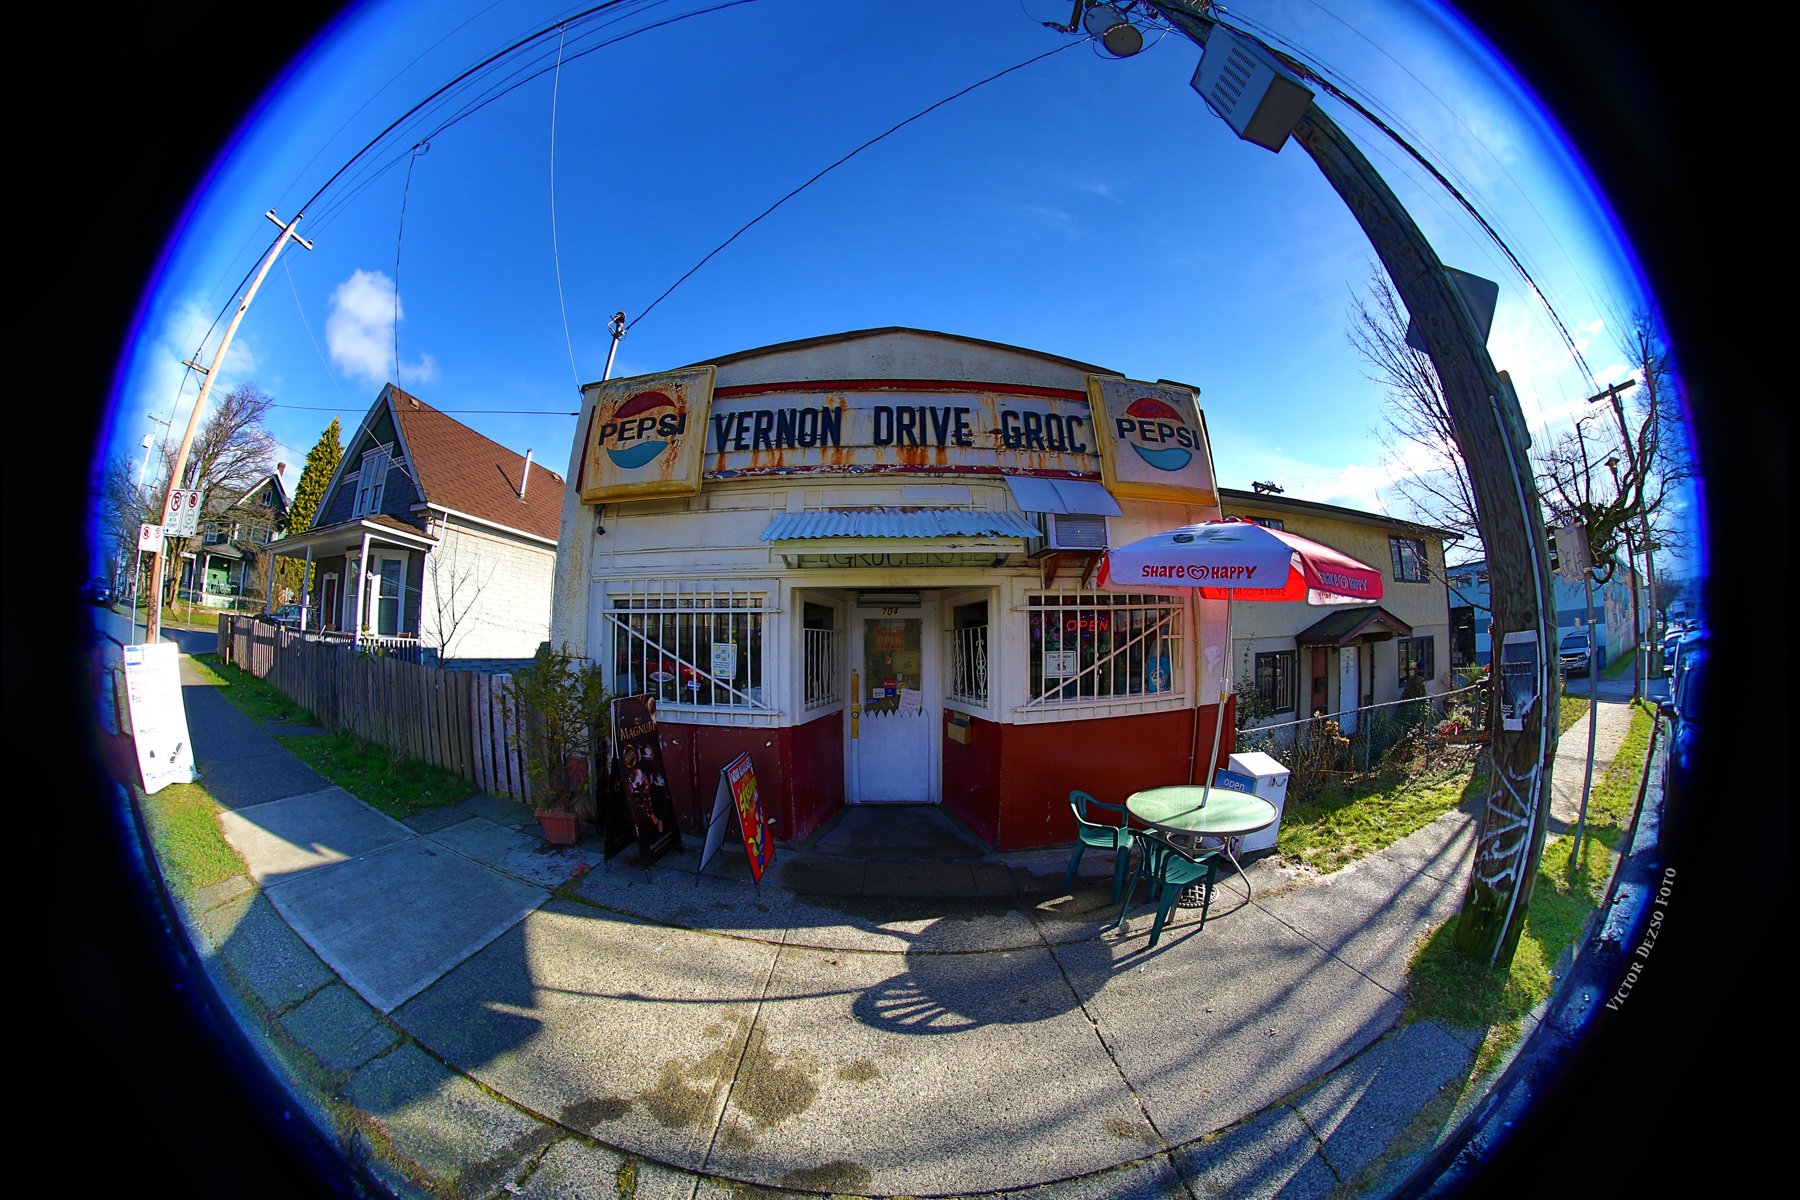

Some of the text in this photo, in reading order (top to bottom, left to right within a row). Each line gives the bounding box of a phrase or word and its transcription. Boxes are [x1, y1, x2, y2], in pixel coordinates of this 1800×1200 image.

[599, 412, 686, 446] PEPSI
[714, 405, 1086, 454] VERNON DRIVE GROC
[1116, 417, 1200, 451] PEPSI
[881, 607, 899, 616] 704
[1066, 619, 1109, 632] OPEN
[877, 634, 902, 645] OPEN
[620, 721, 656, 741] MAGNUM
[1223, 778, 1245, 792] open
